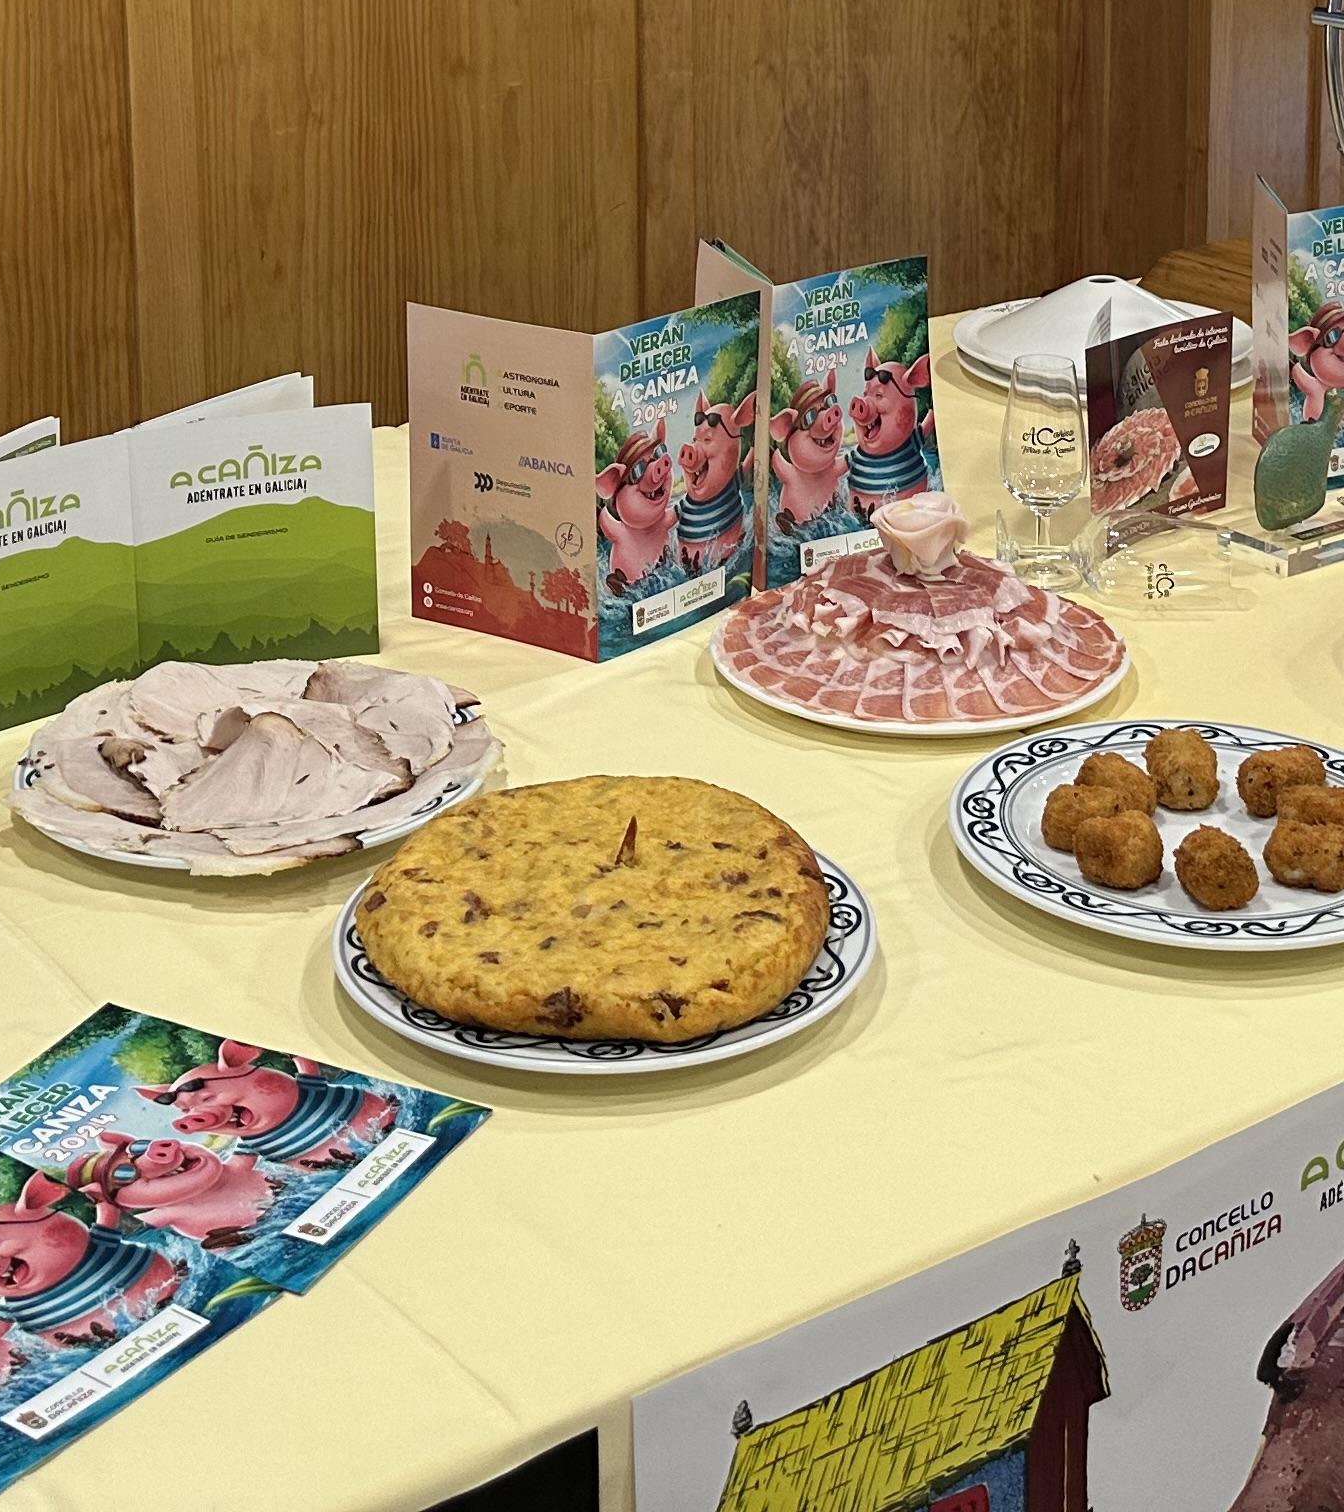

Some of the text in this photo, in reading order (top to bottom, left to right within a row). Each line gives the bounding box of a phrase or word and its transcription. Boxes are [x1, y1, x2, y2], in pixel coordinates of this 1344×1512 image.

[1313, 240, 1332, 257] DE
[629, 323, 685, 358] VERÁN
[620, 344, 692, 383] DE LECER
[630, 365, 700, 404] CAÑIZA
[632, 397, 678, 428] 2024
[198, 444, 322, 485] CAÑIZA
[186, 482, 246, 505] ADÉNTRATE
[248, 481, 262, 496] EN
[11, 530, 24, 544] EN
[1175, 1191, 1274, 1253] CONCELLO
[1165, 1213, 1282, 1290] DACAÑIZA
